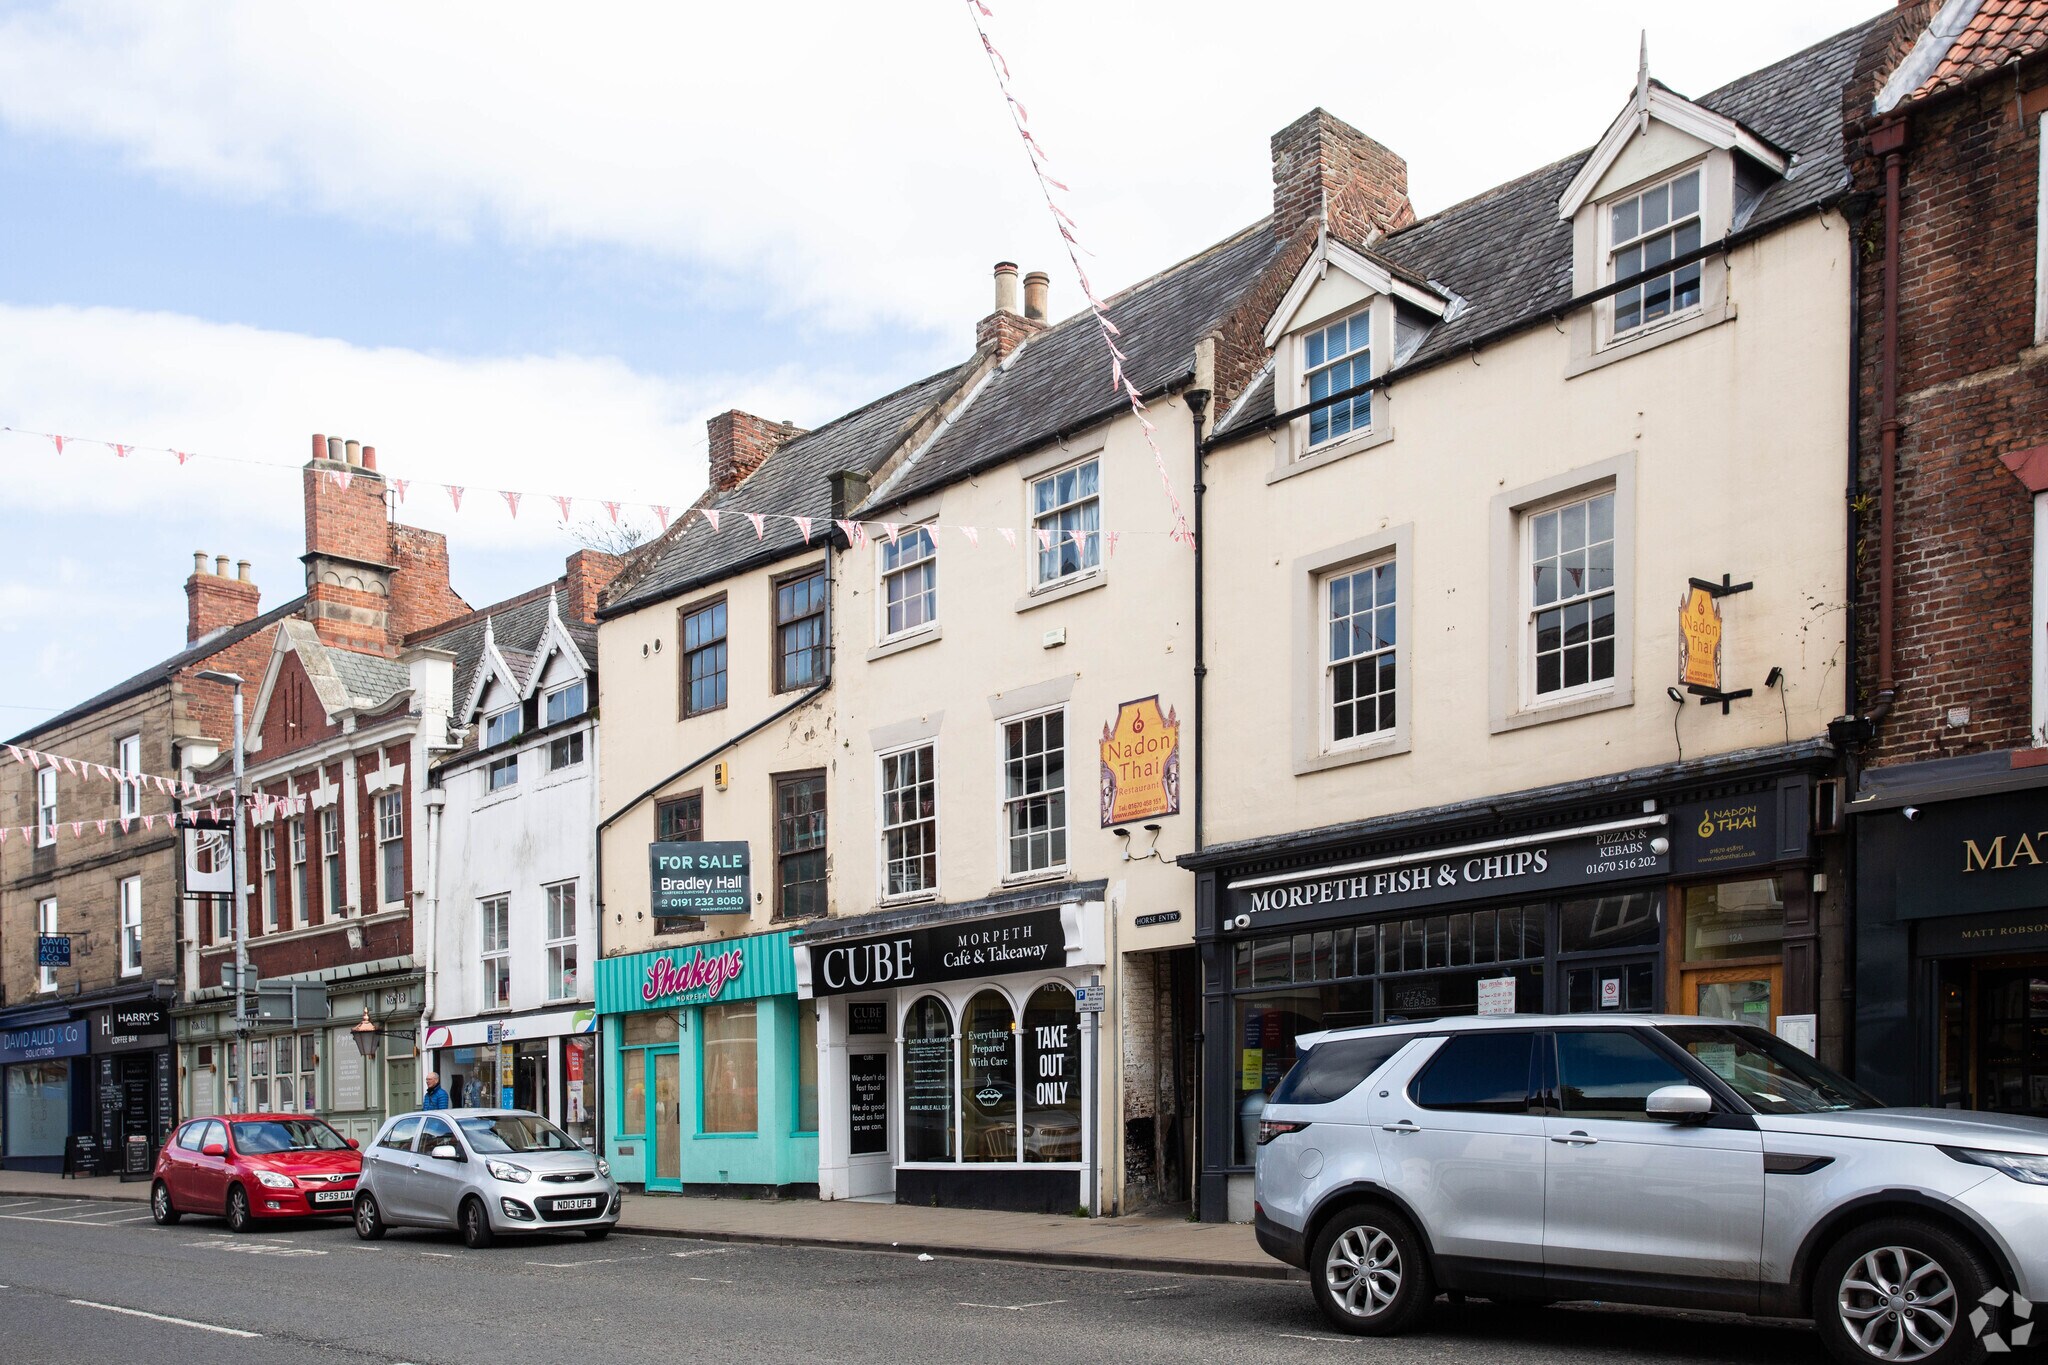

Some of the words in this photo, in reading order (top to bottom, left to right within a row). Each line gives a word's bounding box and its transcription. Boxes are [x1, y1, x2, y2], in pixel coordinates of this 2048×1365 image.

[1685, 614, 1718, 637] Nadon
[1690, 635, 1712, 654] Thai
[1108, 736, 1170, 761] Nadon
[1119, 756, 1159, 780] Thai
[1119, 782, 1160, 796] Restaurant
[1128, 802, 1142, 810] 01670
[1713, 806, 1756, 820] NADON
[1717, 816, 1756, 832] THAI
[1596, 830, 1636, 846] PIZZAS
[1638, 829, 1647, 838] &
[1600, 842, 1643, 858] KEBABS
[660, 856, 693, 870] FOR
[698, 854, 742, 868] SALE
[1586, 862, 1616, 874] 01670
[1618, 858, 1636, 870] 516
[1638, 856, 1656, 868] 202
[661, 876, 712, 894] Bradley
[716, 876, 742, 888] Hall
[1250, 876, 1368, 912] MORPETH
[1373, 866, 1432, 896] FISH
[1436, 864, 1457, 887] &
[1463, 849, 1548, 882] CHIPS
[670, 898, 692, 907] 0191
[694, 897, 714, 906] 232
[716, 896, 744, 905] 8080
[1136, 916, 1156, 925] HORSE
[1158, 912, 1178, 922] ENTRY
[958, 926, 1032, 948] MORPETH
[1728, 933, 1743, 942] 12A
[1962, 928, 1995, 938] MATT
[823, 938, 915, 988] CUBE
[944, 950, 970, 968] Café
[974, 949, 984, 964] &
[987, 944, 1048, 962] Takeaway
[642, 948, 743, 1002] Shakeys
[676, 993, 707, 1002] MORPETH
[1396, 990, 1427, 1000] PIZZAS
[1403, 997, 1437, 1007] KEBABS
[118, 1012, 160, 1022] HARRY'S
[854, 1007, 882, 1018] CUBE
[4, 1031, 30, 1050] DAVID
[31, 1028, 55, 1046] AULD
[57, 1027, 63, 1043] &
[65, 1026, 78, 1042] Co
[112, 1035, 128, 1044] COFFEE
[128, 1035, 138, 1043] BAR
[968, 1029, 1009, 1042] Everything
[1036, 1025, 1068, 1049] TAKE
[25, 1047, 55, 1058] SOLICITORS
[972, 1043, 1005, 1055] Prepared
[970, 1058, 989, 1067] With
[990, 1057, 1008, 1066] Care
[1039, 1053, 1065, 1077] OUT
[1036, 1082, 1068, 1105] ONLY
[871, 1103, 885, 1112] good
[557, 1201, 575, 1210] ND13
[576, 1199, 592, 1208] UFB
